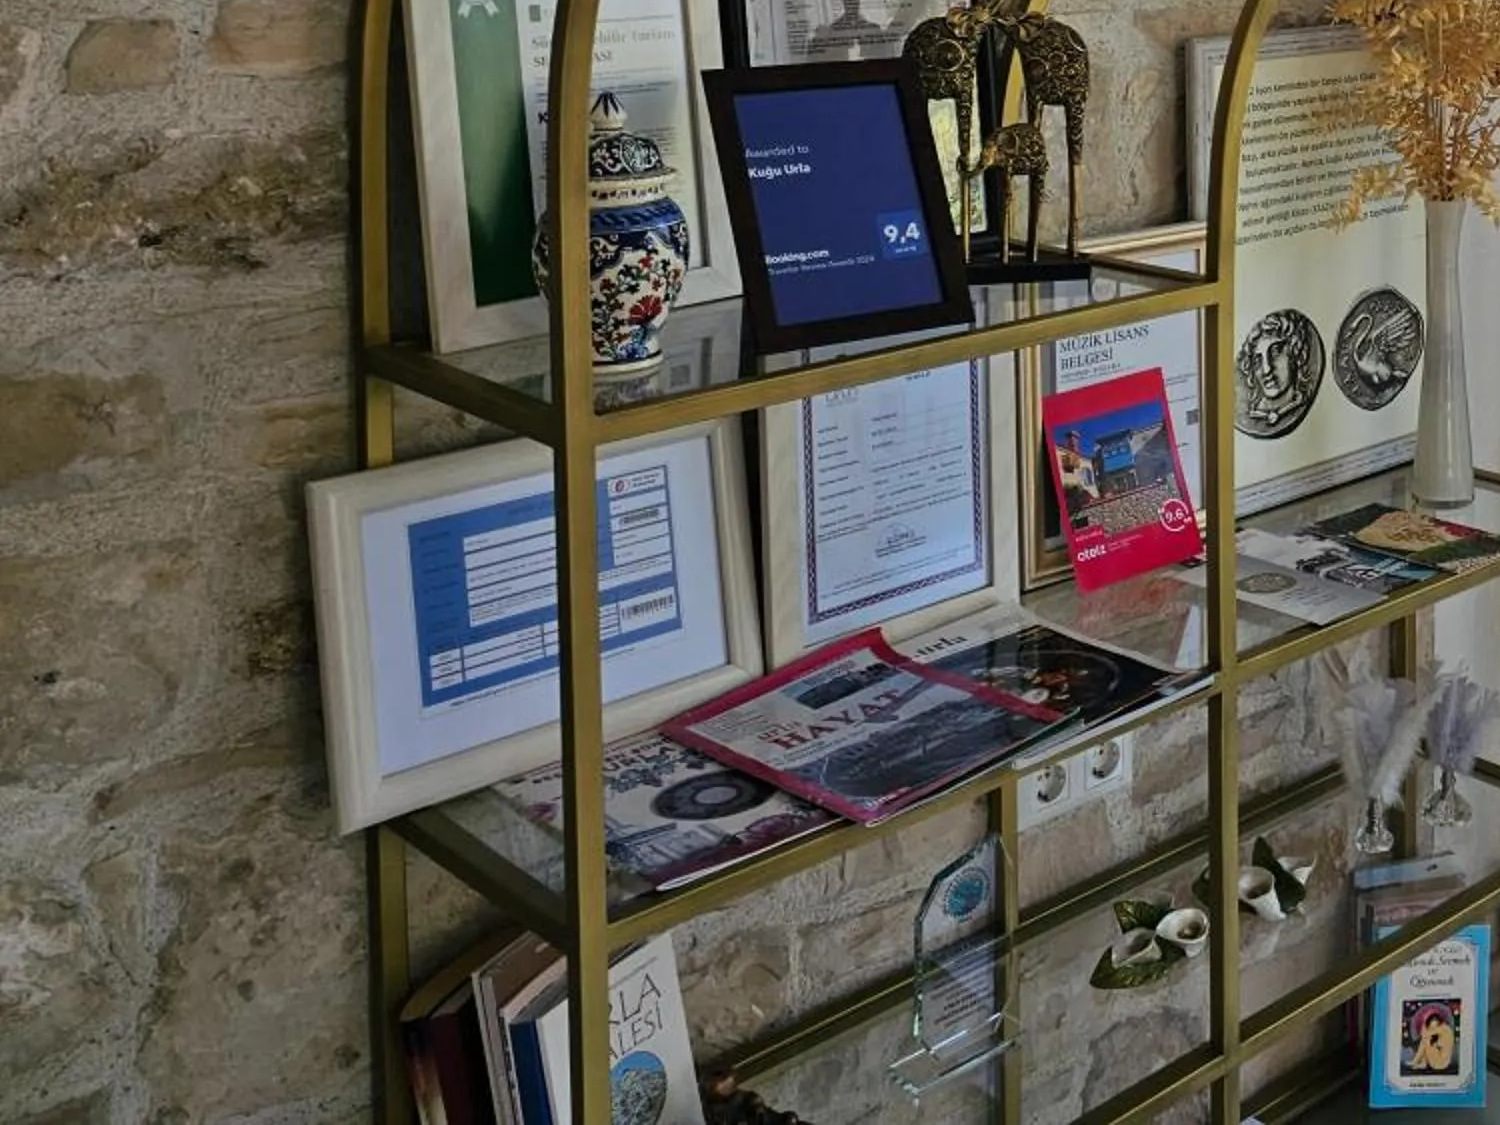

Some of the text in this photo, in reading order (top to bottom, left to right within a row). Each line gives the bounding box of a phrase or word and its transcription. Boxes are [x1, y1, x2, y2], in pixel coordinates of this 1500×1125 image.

[796, 144, 810, 155] to
[747, 162, 812, 180] Kuğu Urla
[883, 222, 921, 245] 9,4
[765, 248, 831, 266] Booking.com
[1059, 324, 1150, 354] MÜZİK LİSANS
[1060, 347, 1114, 372] BELGESİ
[768, 689, 903, 751] HAYAT
[608, 972, 662, 1025] RLA
